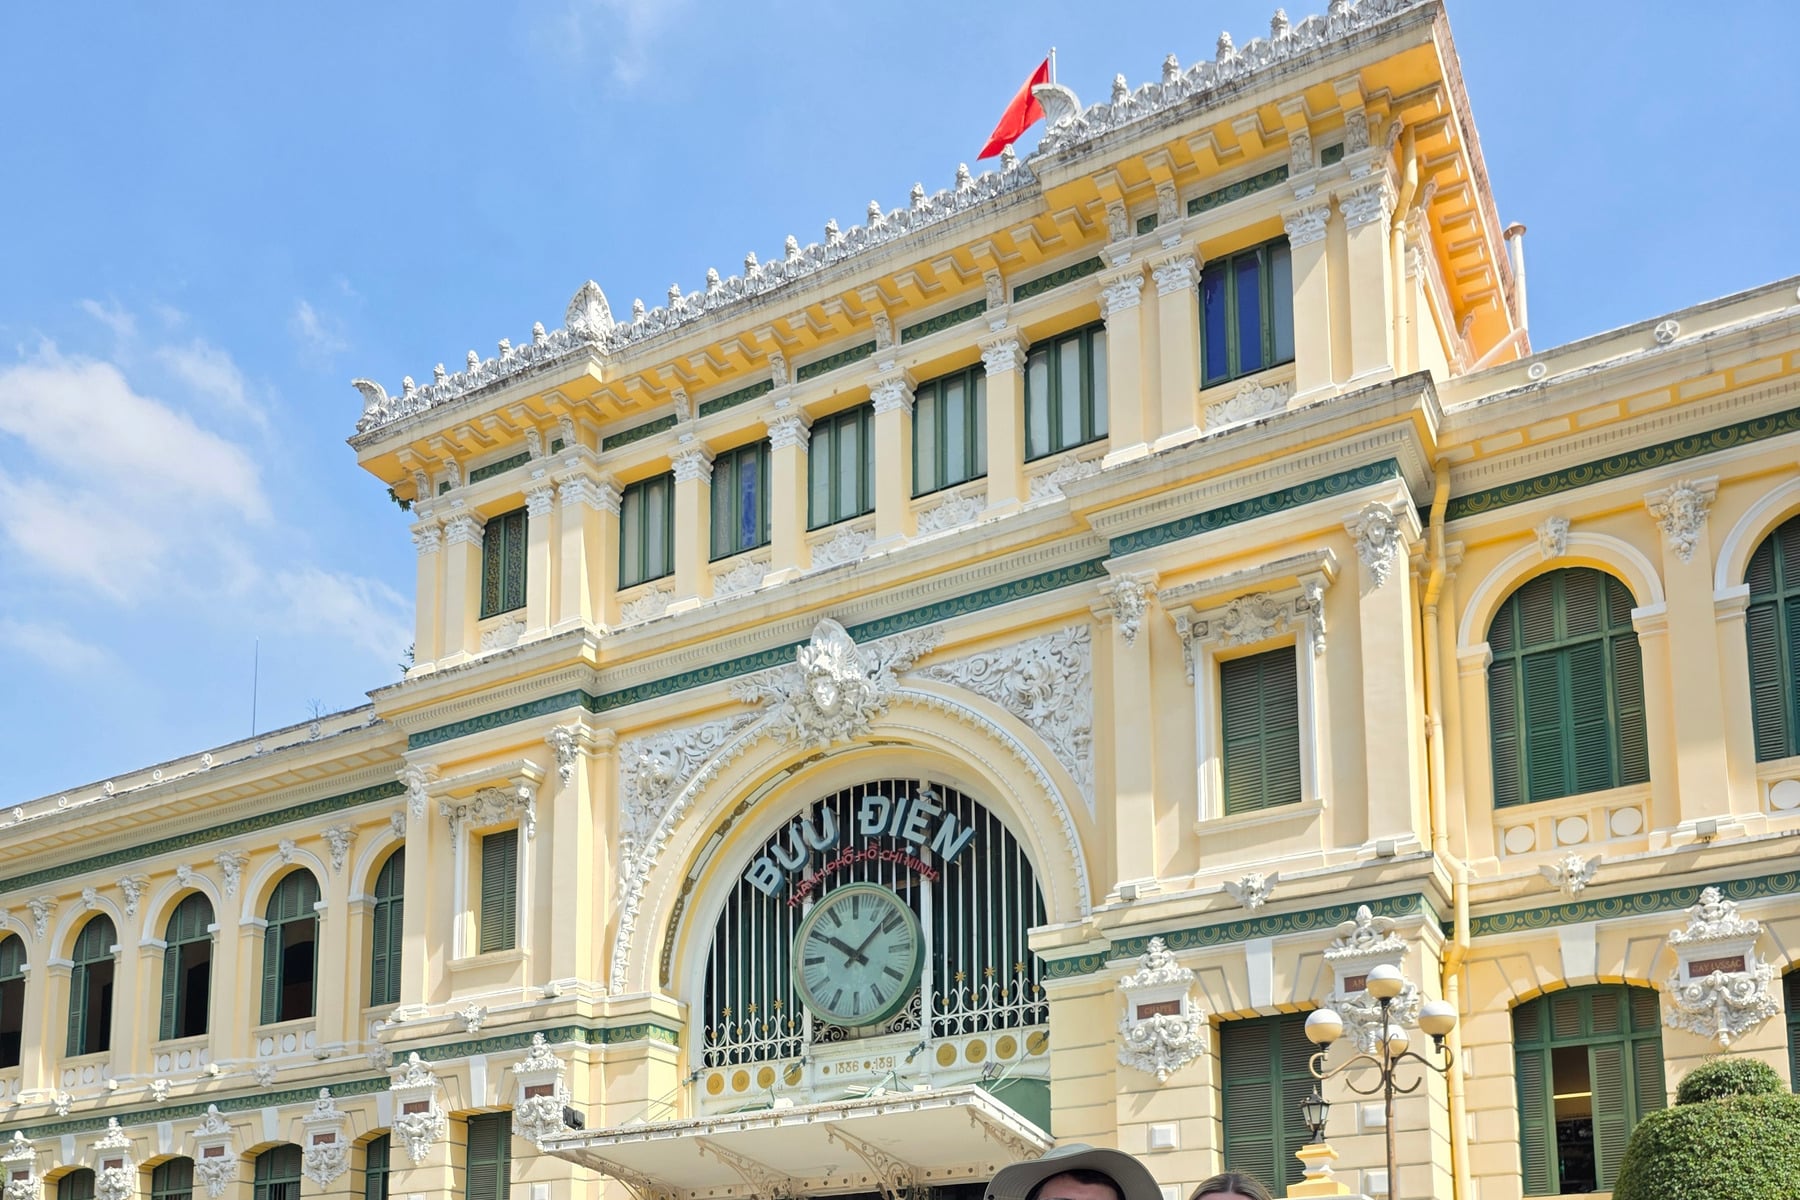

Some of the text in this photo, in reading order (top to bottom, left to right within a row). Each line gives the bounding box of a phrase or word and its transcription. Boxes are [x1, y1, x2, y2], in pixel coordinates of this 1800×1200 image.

[858, 790, 976, 864] ĐIỆN
[904, 855, 939, 882] MINH
[835, 1056, 896, 1075] 1886 1891
